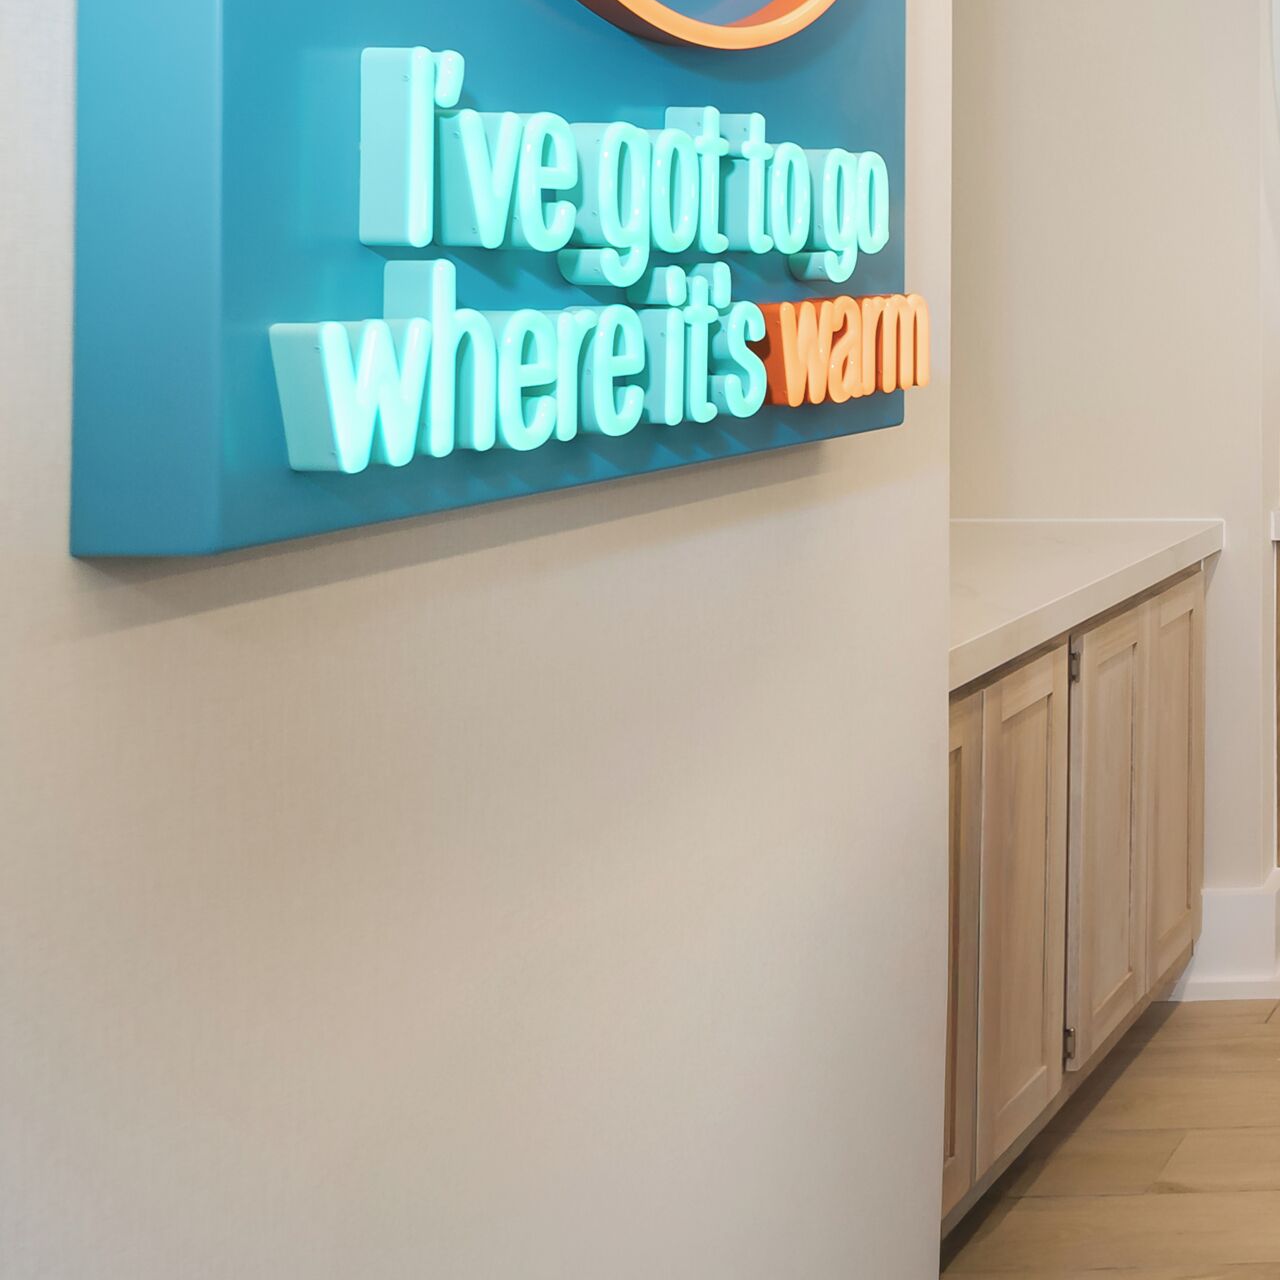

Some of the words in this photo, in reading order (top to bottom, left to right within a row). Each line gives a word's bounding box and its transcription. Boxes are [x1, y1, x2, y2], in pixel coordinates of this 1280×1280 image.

[361, 45, 579, 254] I've
[560, 104, 731, 288] got
[728, 109, 812, 255] to
[790, 148, 890, 284] go
[270, 258, 646, 475] where
[636, 260, 768, 426] it's
[762, 292, 931, 408] warm
